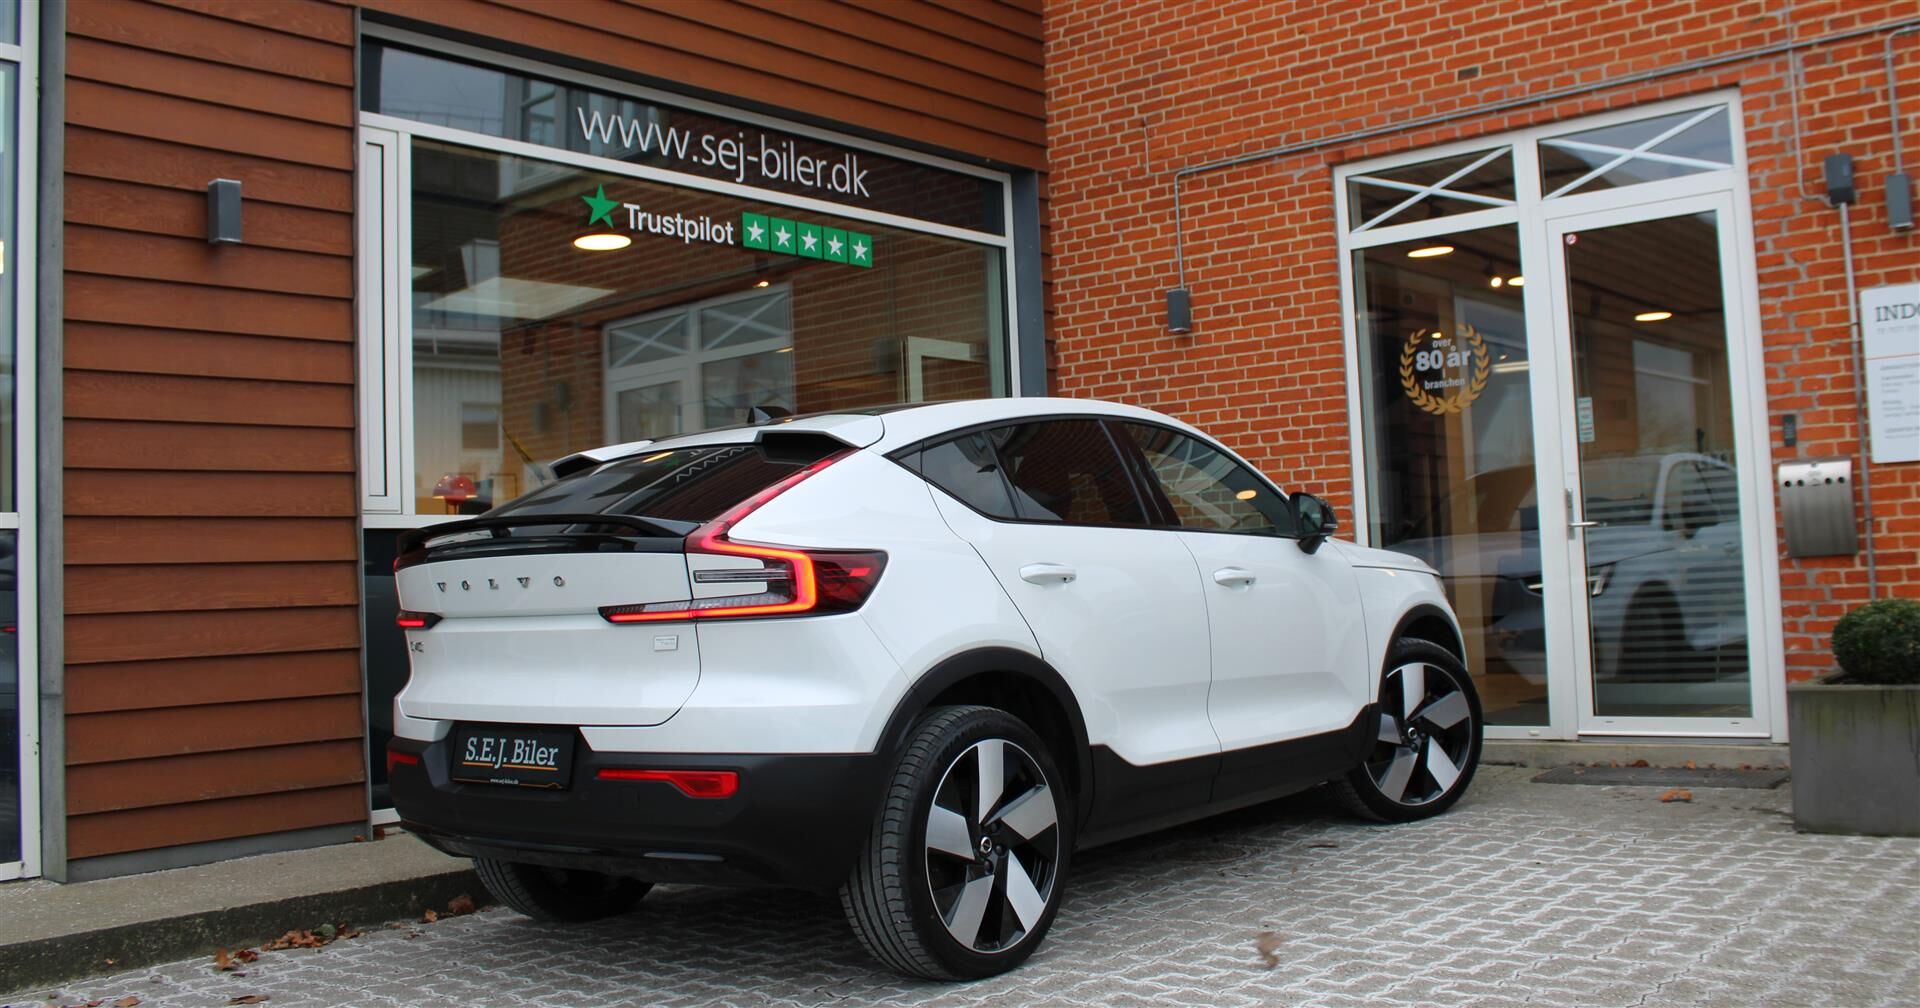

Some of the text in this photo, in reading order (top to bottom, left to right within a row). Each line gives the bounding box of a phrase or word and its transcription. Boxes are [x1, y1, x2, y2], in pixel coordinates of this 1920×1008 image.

[577, 107, 870, 198] www.sej-biler.dk
[623, 203, 735, 245] Trustpilot
[1875, 303, 1920, 322] IND
[1432, 339, 1452, 348] over
[1415, 345, 1472, 372] 80 år
[1424, 378, 1465, 390] branchen
[437, 575, 565, 593] VOLVO
[465, 737, 559, 769] S.E.J. Biler
